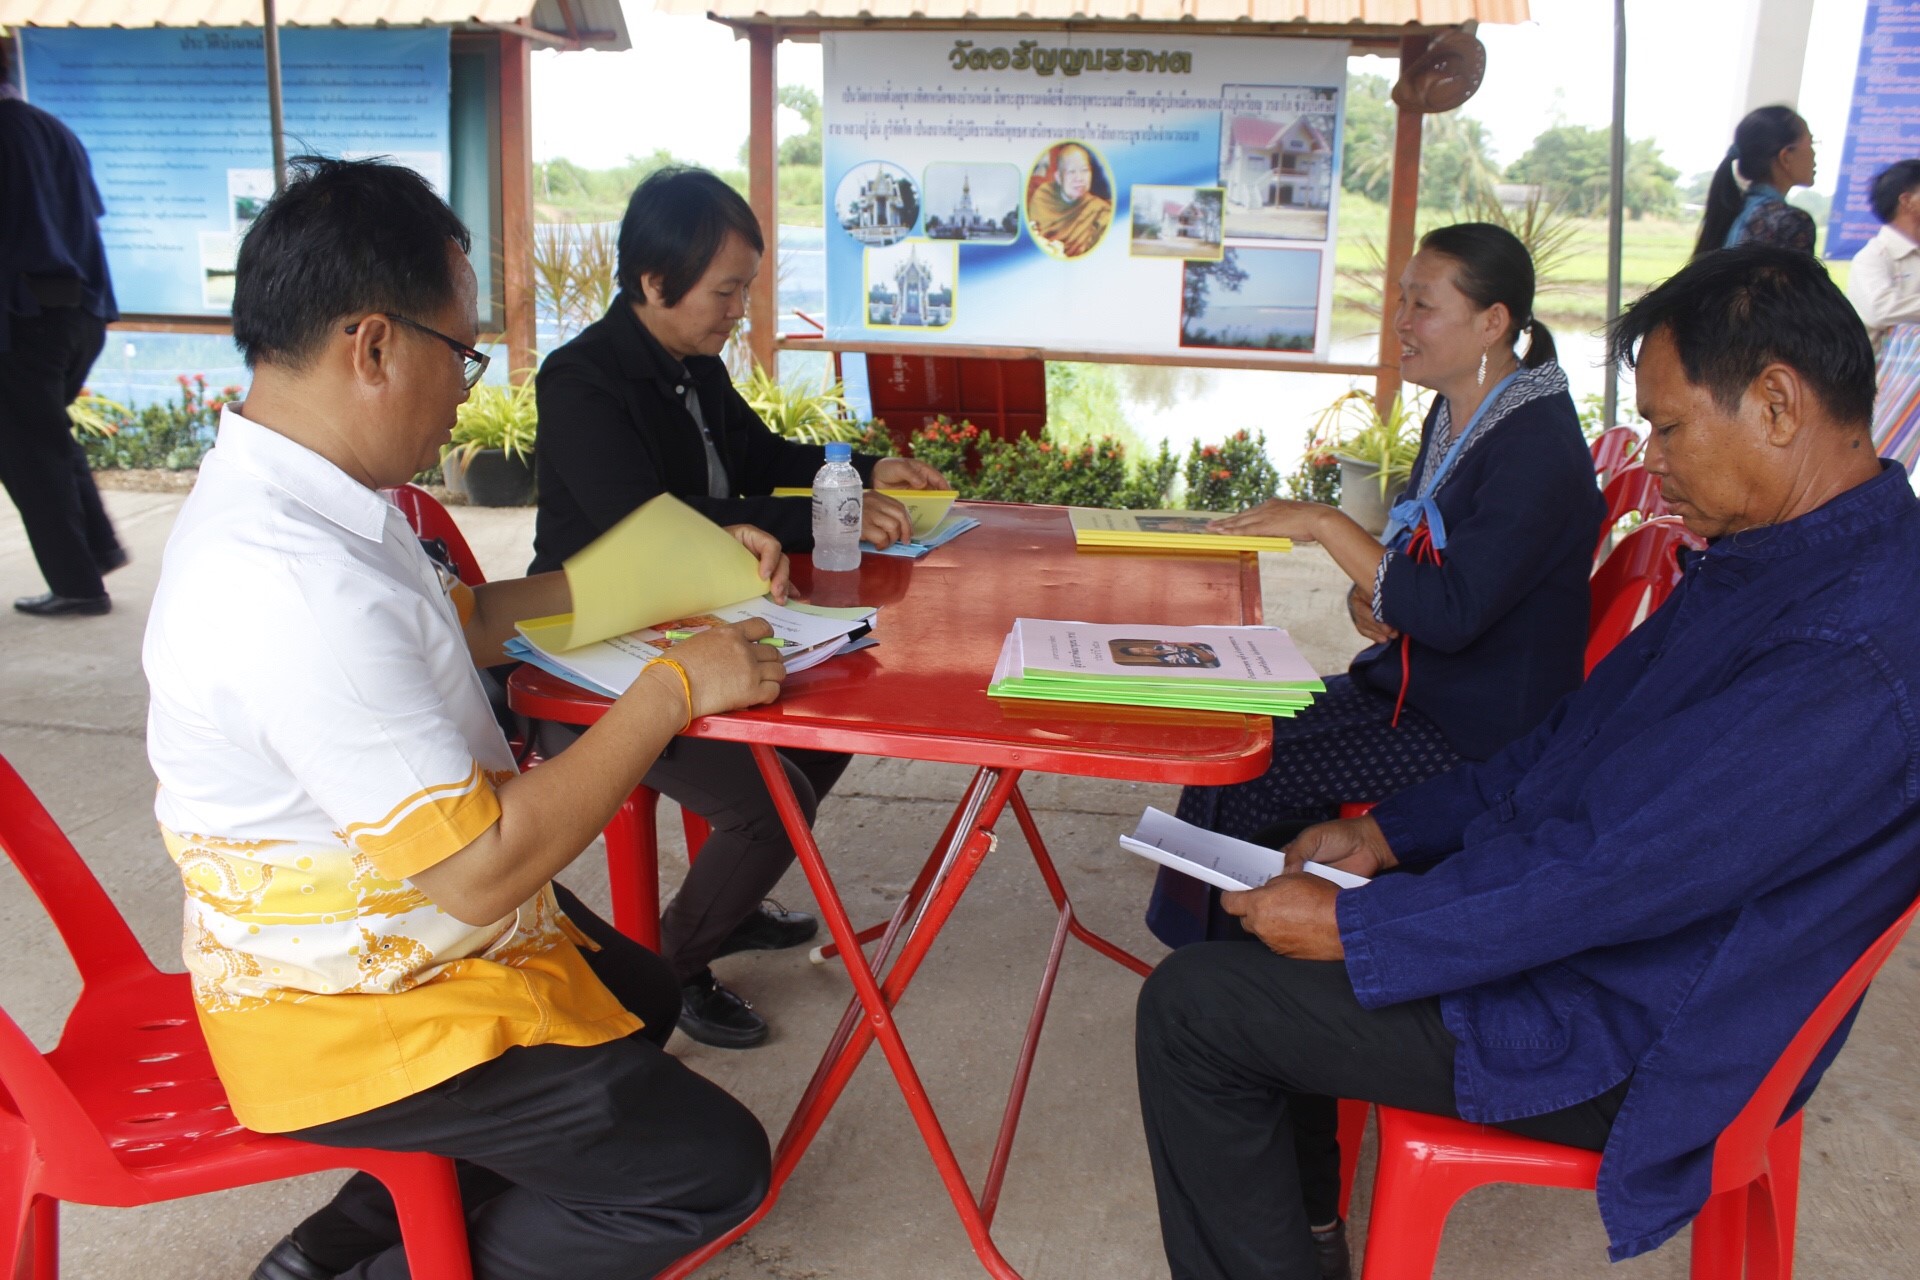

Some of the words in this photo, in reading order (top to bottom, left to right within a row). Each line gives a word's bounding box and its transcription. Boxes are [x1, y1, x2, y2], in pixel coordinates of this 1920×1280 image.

[949, 40, 1193, 76] วัดอรัญญบรรพต
